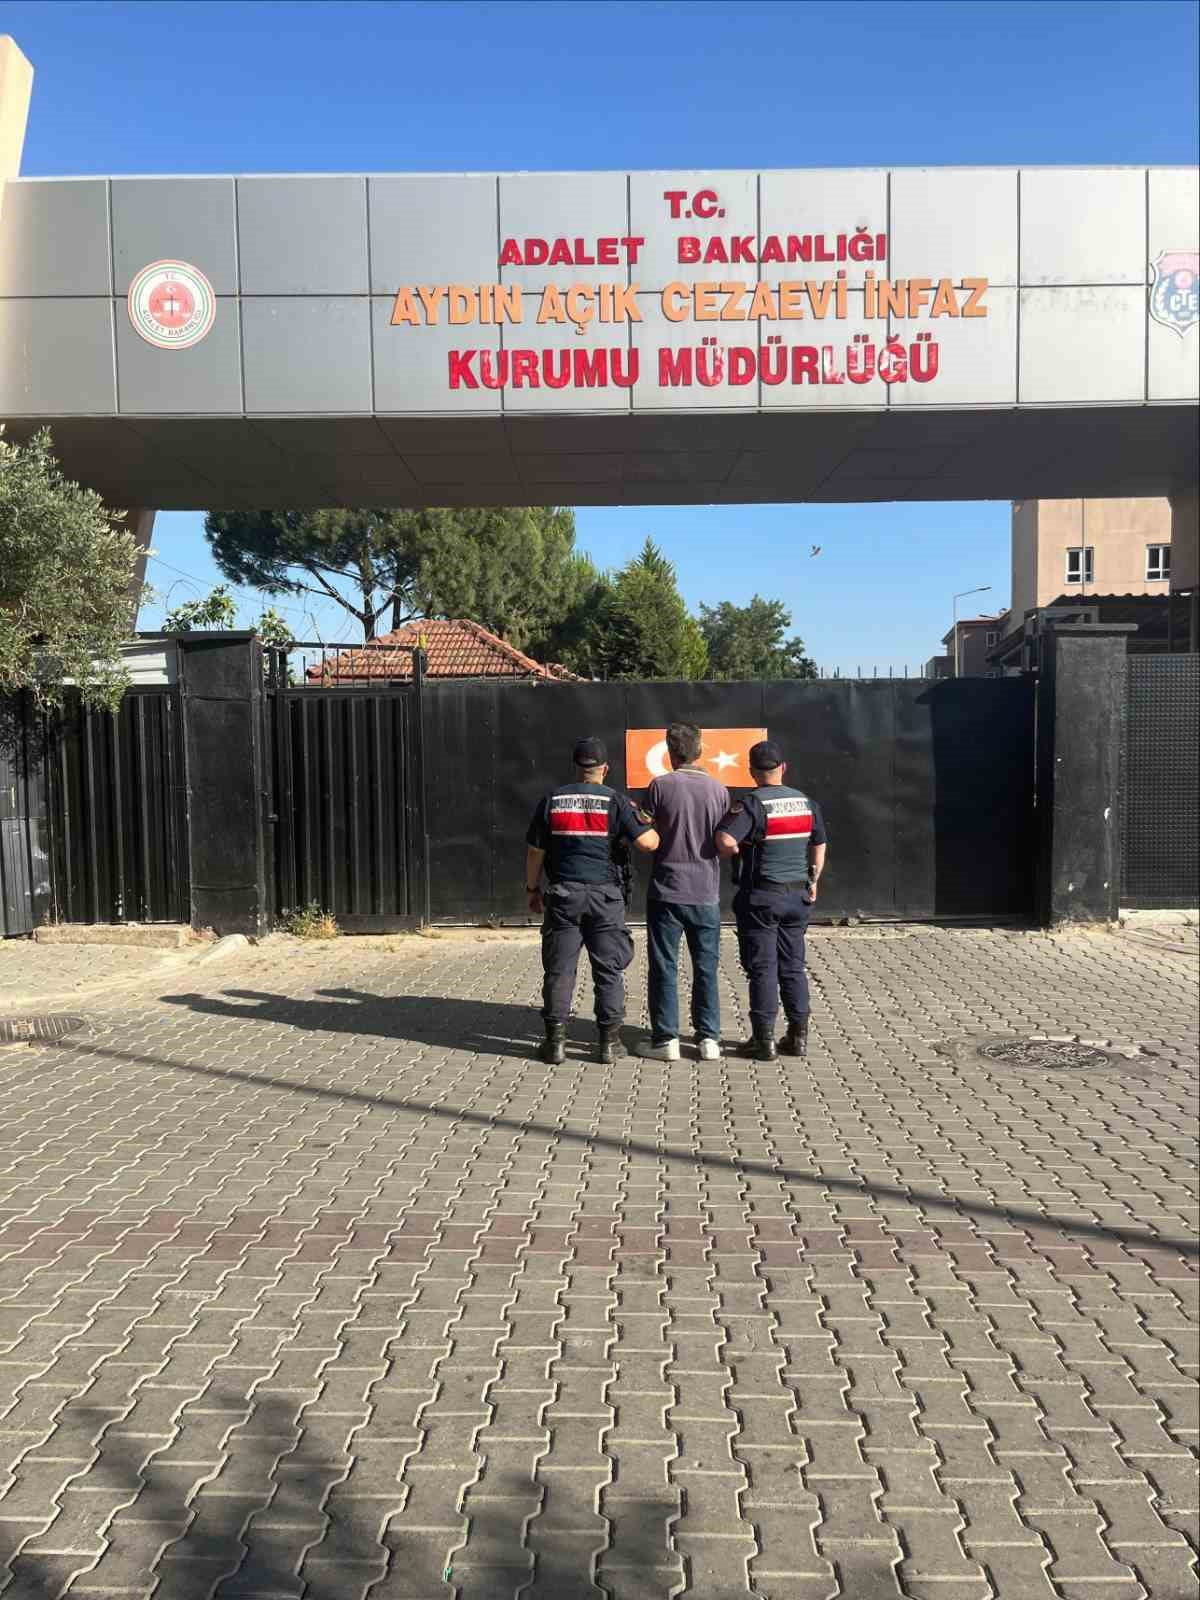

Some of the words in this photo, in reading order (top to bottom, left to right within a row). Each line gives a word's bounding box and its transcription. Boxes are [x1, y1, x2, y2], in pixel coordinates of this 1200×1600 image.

[664, 190, 726, 219] T.C.
[499, 237, 644, 266] ADALET
[678, 227, 887, 264] BAKANLIĞI
[390, 286, 523, 326] AYDIN
[537, 284, 644, 335] AÇIK
[661, 270, 849, 322] CEZAEVİ
[864, 270, 989, 320] İNFAZ
[448, 345, 640, 390] KURUMU
[658, 332, 939, 388] MÜDÜRLÜĞÜ
